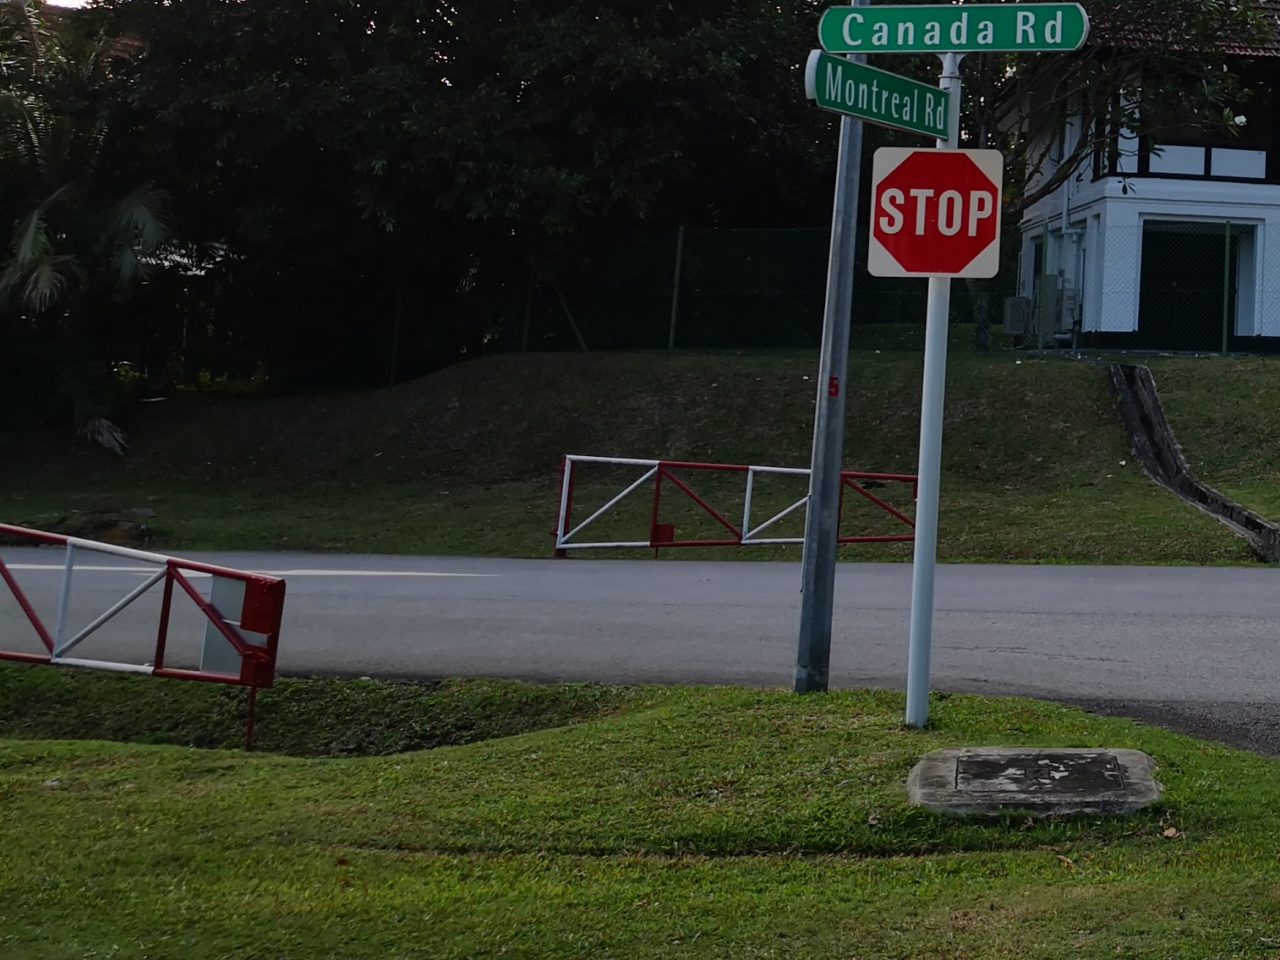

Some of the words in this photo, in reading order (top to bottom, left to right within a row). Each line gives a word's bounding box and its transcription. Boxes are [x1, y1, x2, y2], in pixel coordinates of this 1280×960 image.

[843, 12, 994, 46] Canada
[1016, 10, 1063, 44] Rd
[825, 62, 917, 123] Montreal
[925, 93, 945, 130] Rd
[879, 188, 993, 237] STOP
